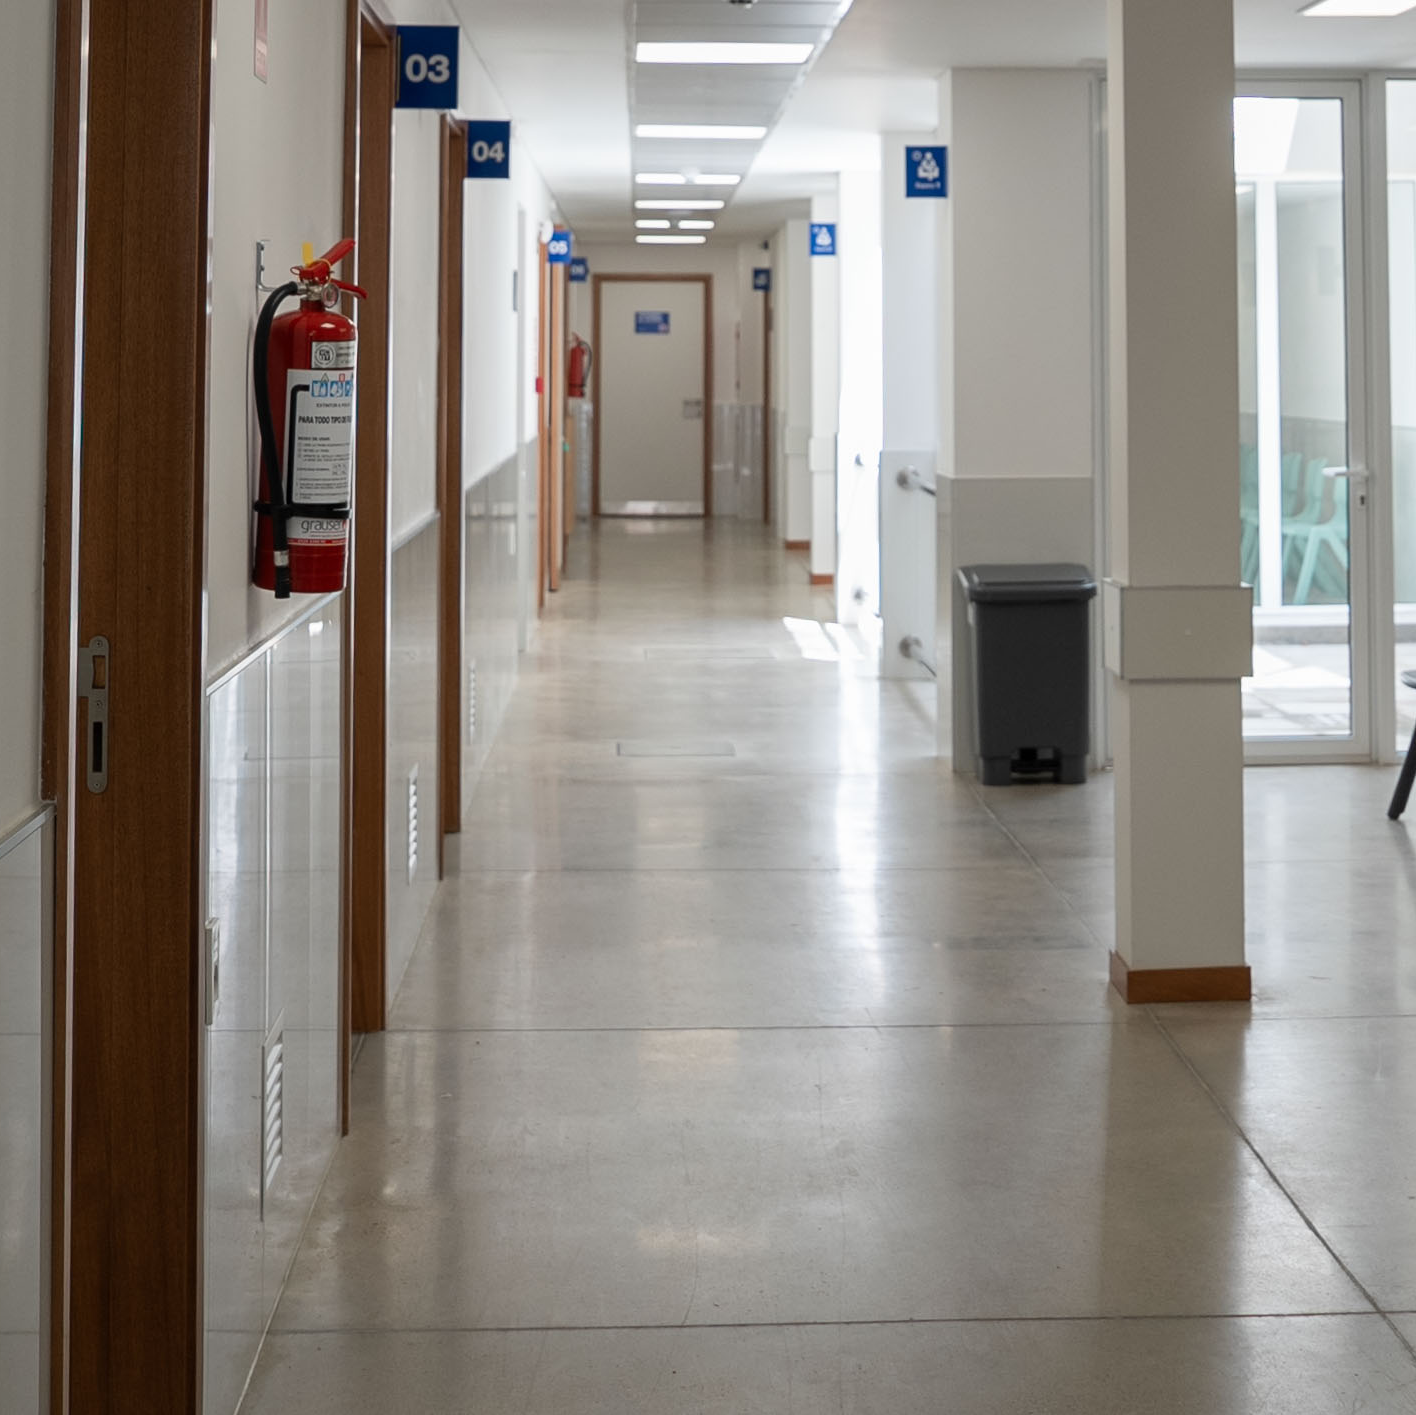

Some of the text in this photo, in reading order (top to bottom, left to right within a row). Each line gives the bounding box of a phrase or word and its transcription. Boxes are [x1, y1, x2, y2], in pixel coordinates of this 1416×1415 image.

[405, 53, 451, 84] 03
[472, 140, 505, 163] 04
[548, 239, 569, 255] 05
[298, 415, 314, 424] PARA
[315, 416, 330, 424] TODO
